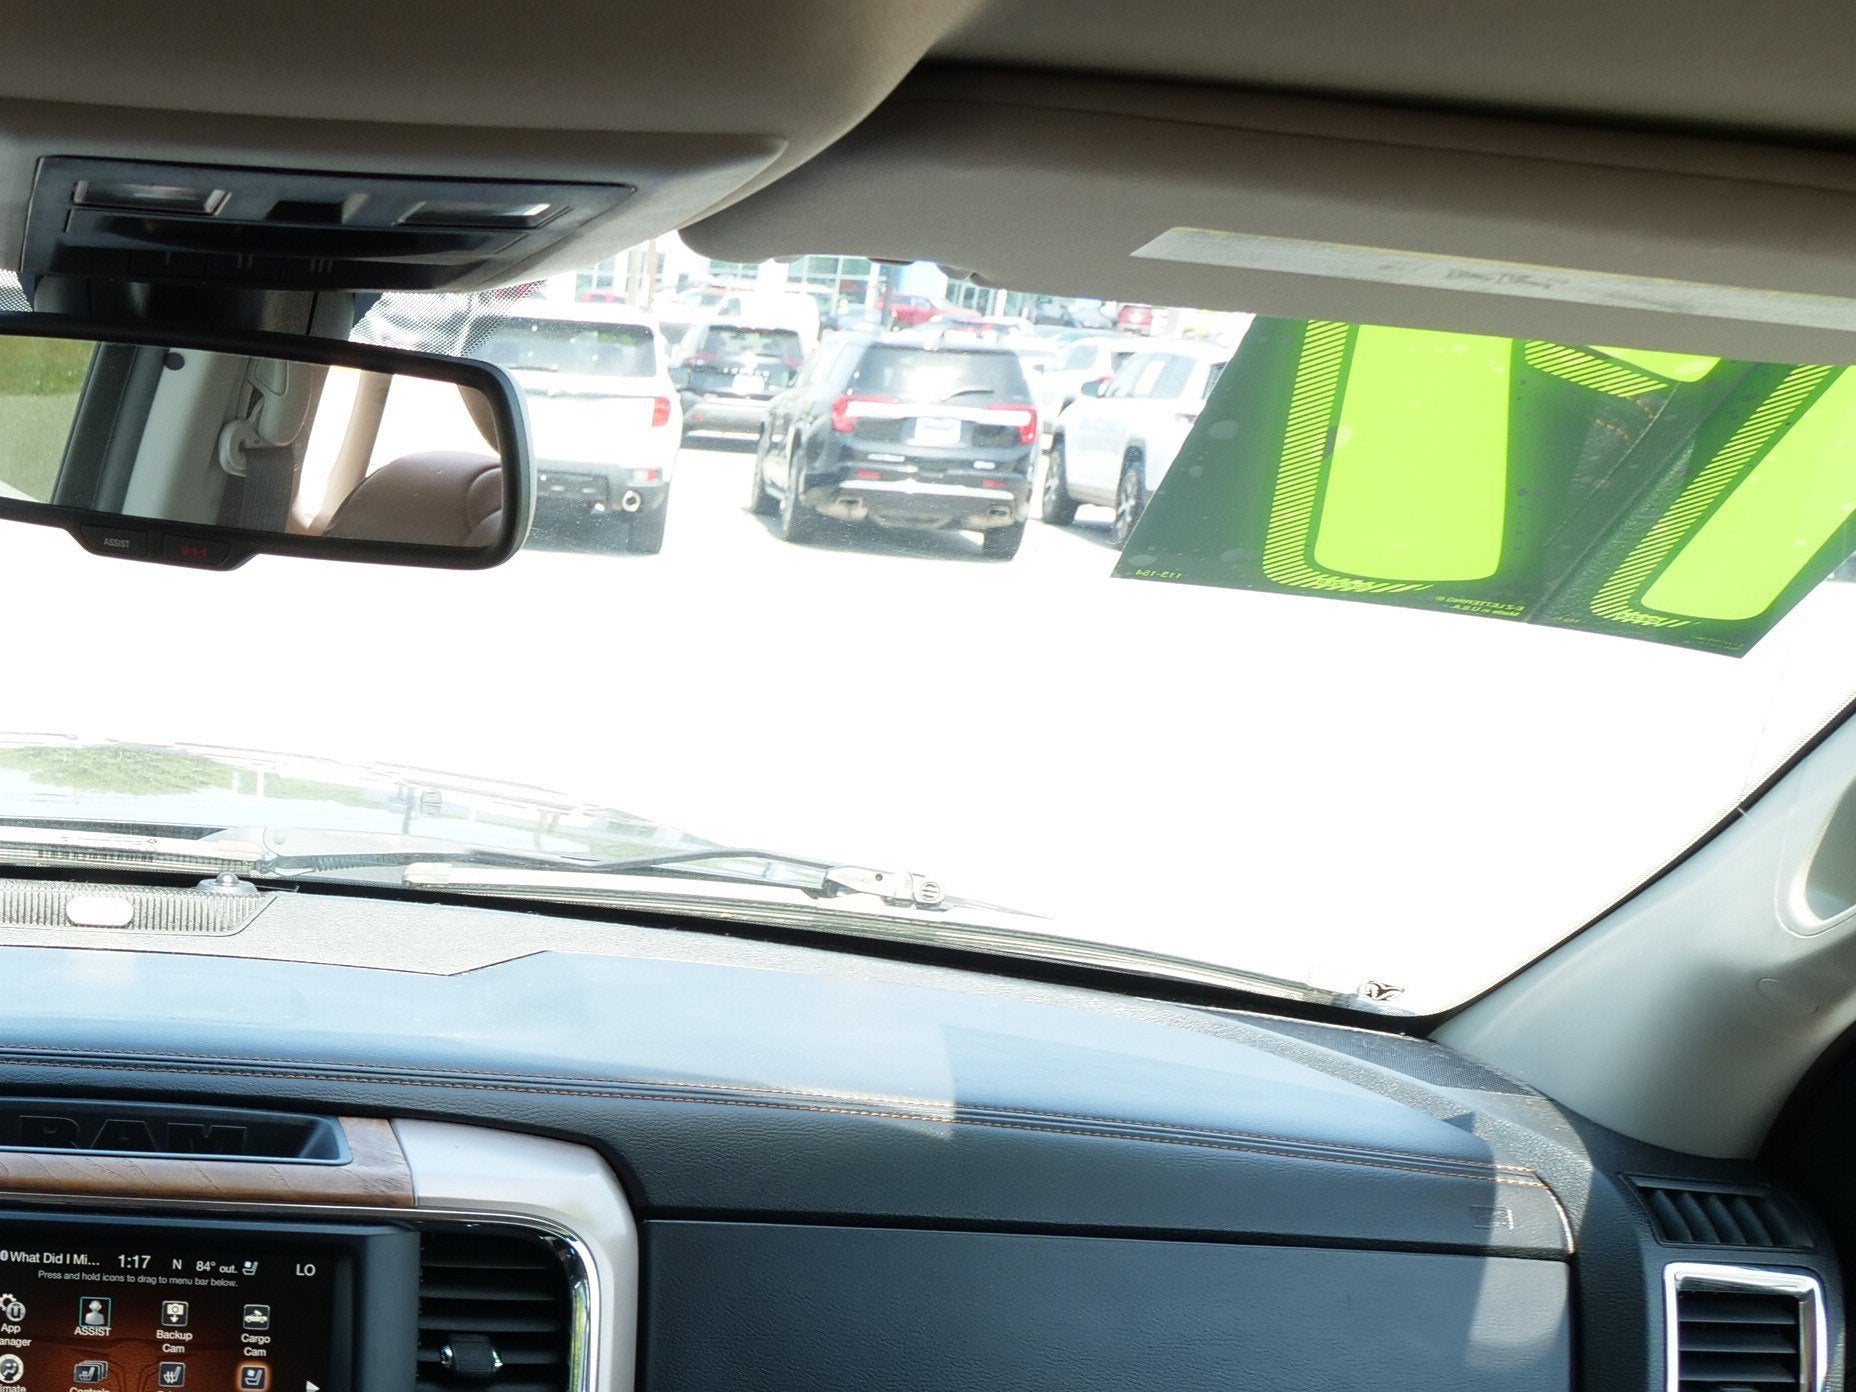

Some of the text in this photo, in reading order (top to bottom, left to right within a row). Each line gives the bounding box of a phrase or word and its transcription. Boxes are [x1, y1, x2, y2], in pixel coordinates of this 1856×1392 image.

[104, 538, 130, 548] ASSIST
[10, 1251, 40, 1263] What
[44, 1253, 63, 1264] Did
[118, 1254, 151, 1269] 1:17
[172, 1259, 182, 1270] N
[219, 1264, 238, 1274] out.
[296, 1263, 316, 1277] LO
[38, 1270, 238, 1287] Press and hold icons to drag to menu bar below.
[1, 1323, 21, 1334] App
[74, 1326, 112, 1337] ASSIST
[156, 1330, 193, 1341] Backup
[240, 1333, 271, 1345] Cargo
[162, 1343, 185, 1354] Cam
[243, 1347, 267, 1357] Cam
